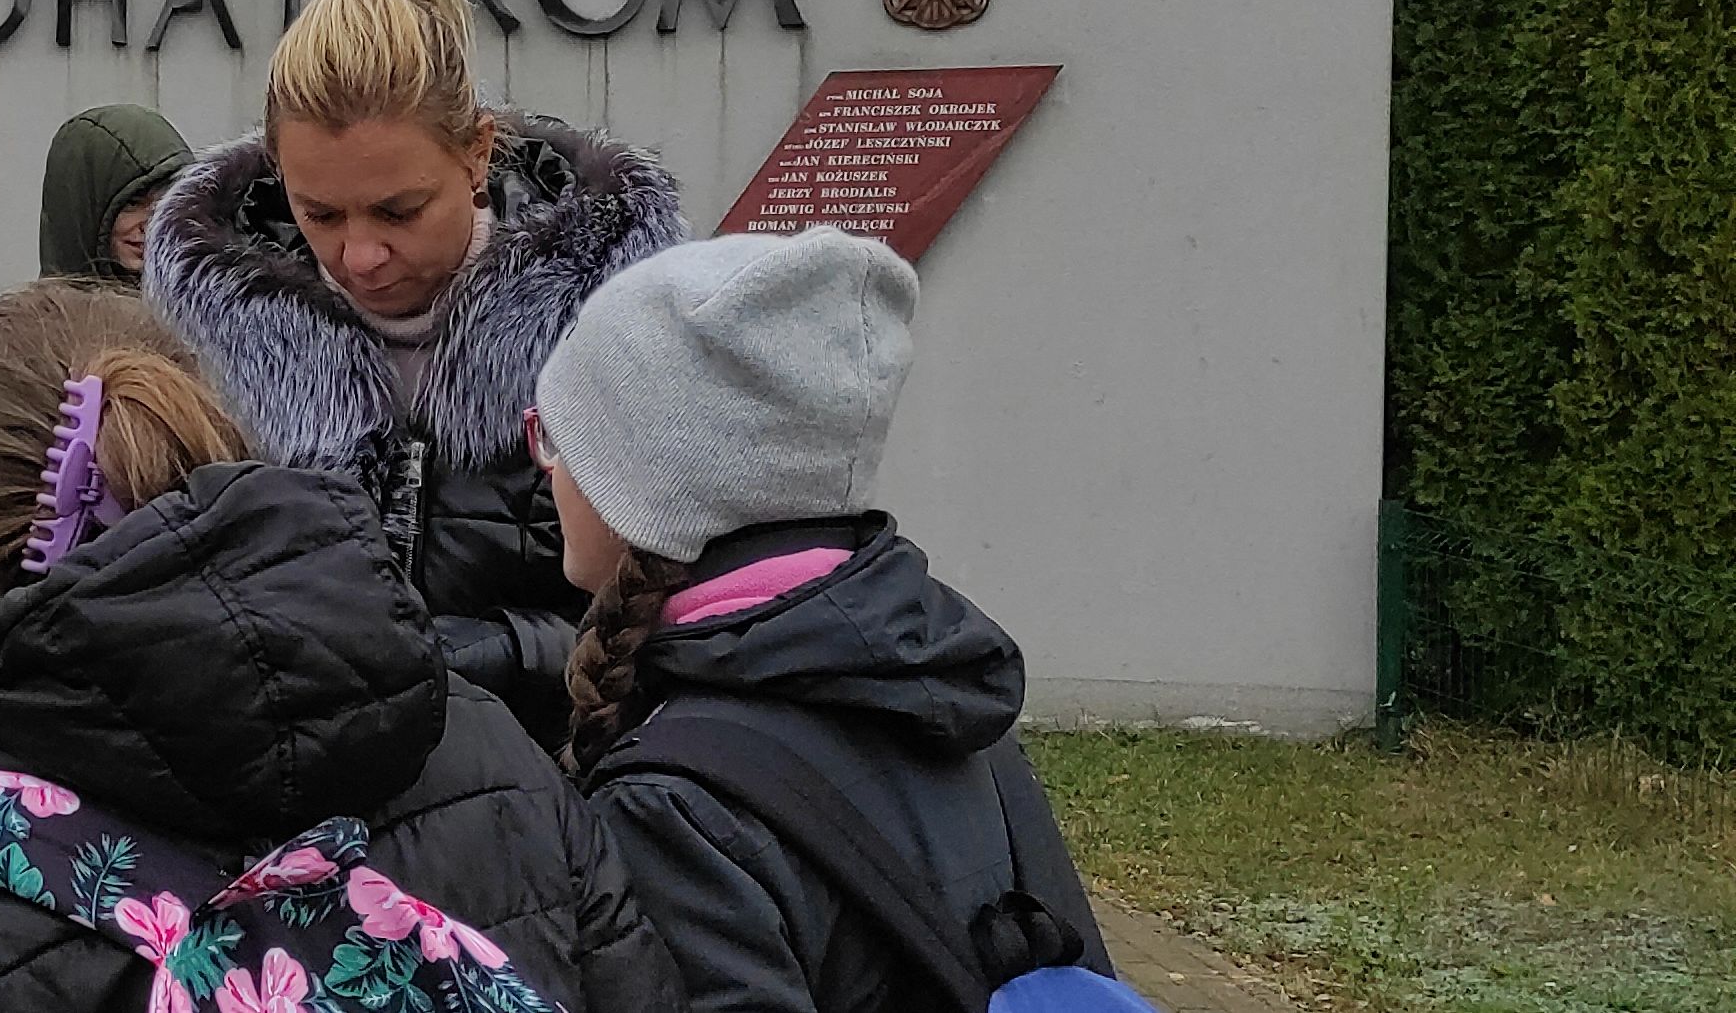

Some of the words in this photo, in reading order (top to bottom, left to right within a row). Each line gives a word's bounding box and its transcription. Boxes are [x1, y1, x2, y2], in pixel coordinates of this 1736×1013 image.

[907, 87, 944, 99] SOJA
[833, 104, 922, 117] FRANCISZEK
[929, 102, 997, 115] OKROJEK
[805, 136, 849, 149] JÓZEF
[856, 135, 952, 148] LESZCZYŃSKI
[794, 154, 820, 166] JAN
[781, 171, 809, 183] JAN
[815, 169, 889, 183] KOŻUSZEK
[767, 187, 813, 200] JERZY
[760, 203, 815, 215] LUDWIG
[821, 202, 911, 215] JANCZEWSKI
